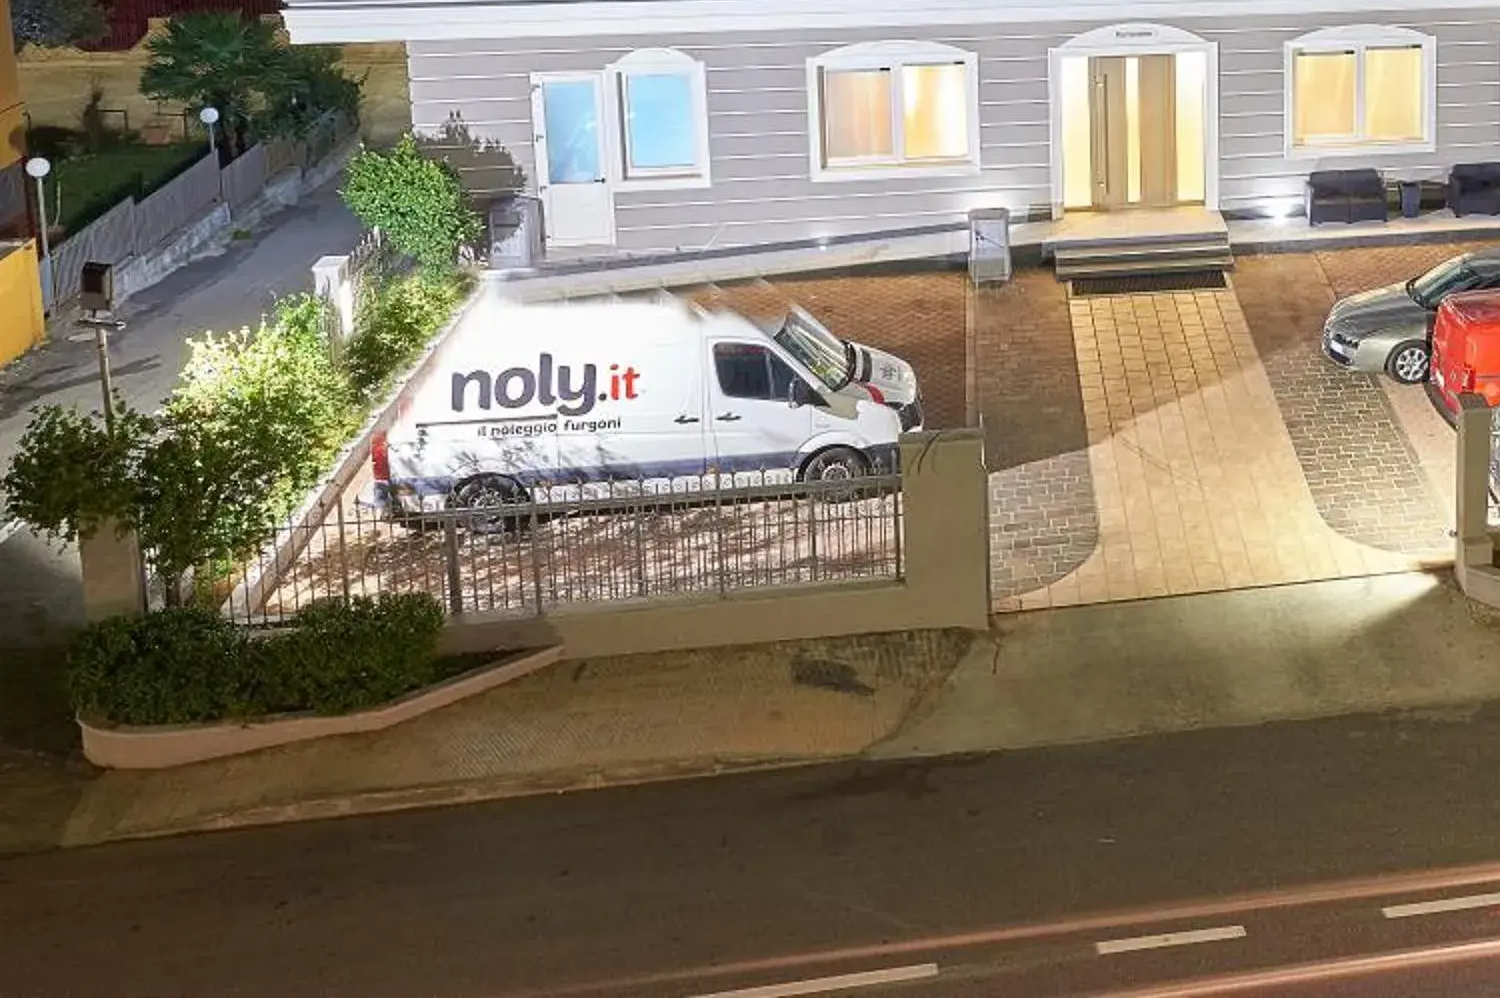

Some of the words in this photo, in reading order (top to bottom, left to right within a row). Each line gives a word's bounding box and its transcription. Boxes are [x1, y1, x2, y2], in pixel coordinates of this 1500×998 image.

[451, 352, 641, 417] noly.it
[477, 426, 487, 437] il
[490, 422, 557, 439] noleggio
[563, 417, 622, 434] furgoni
